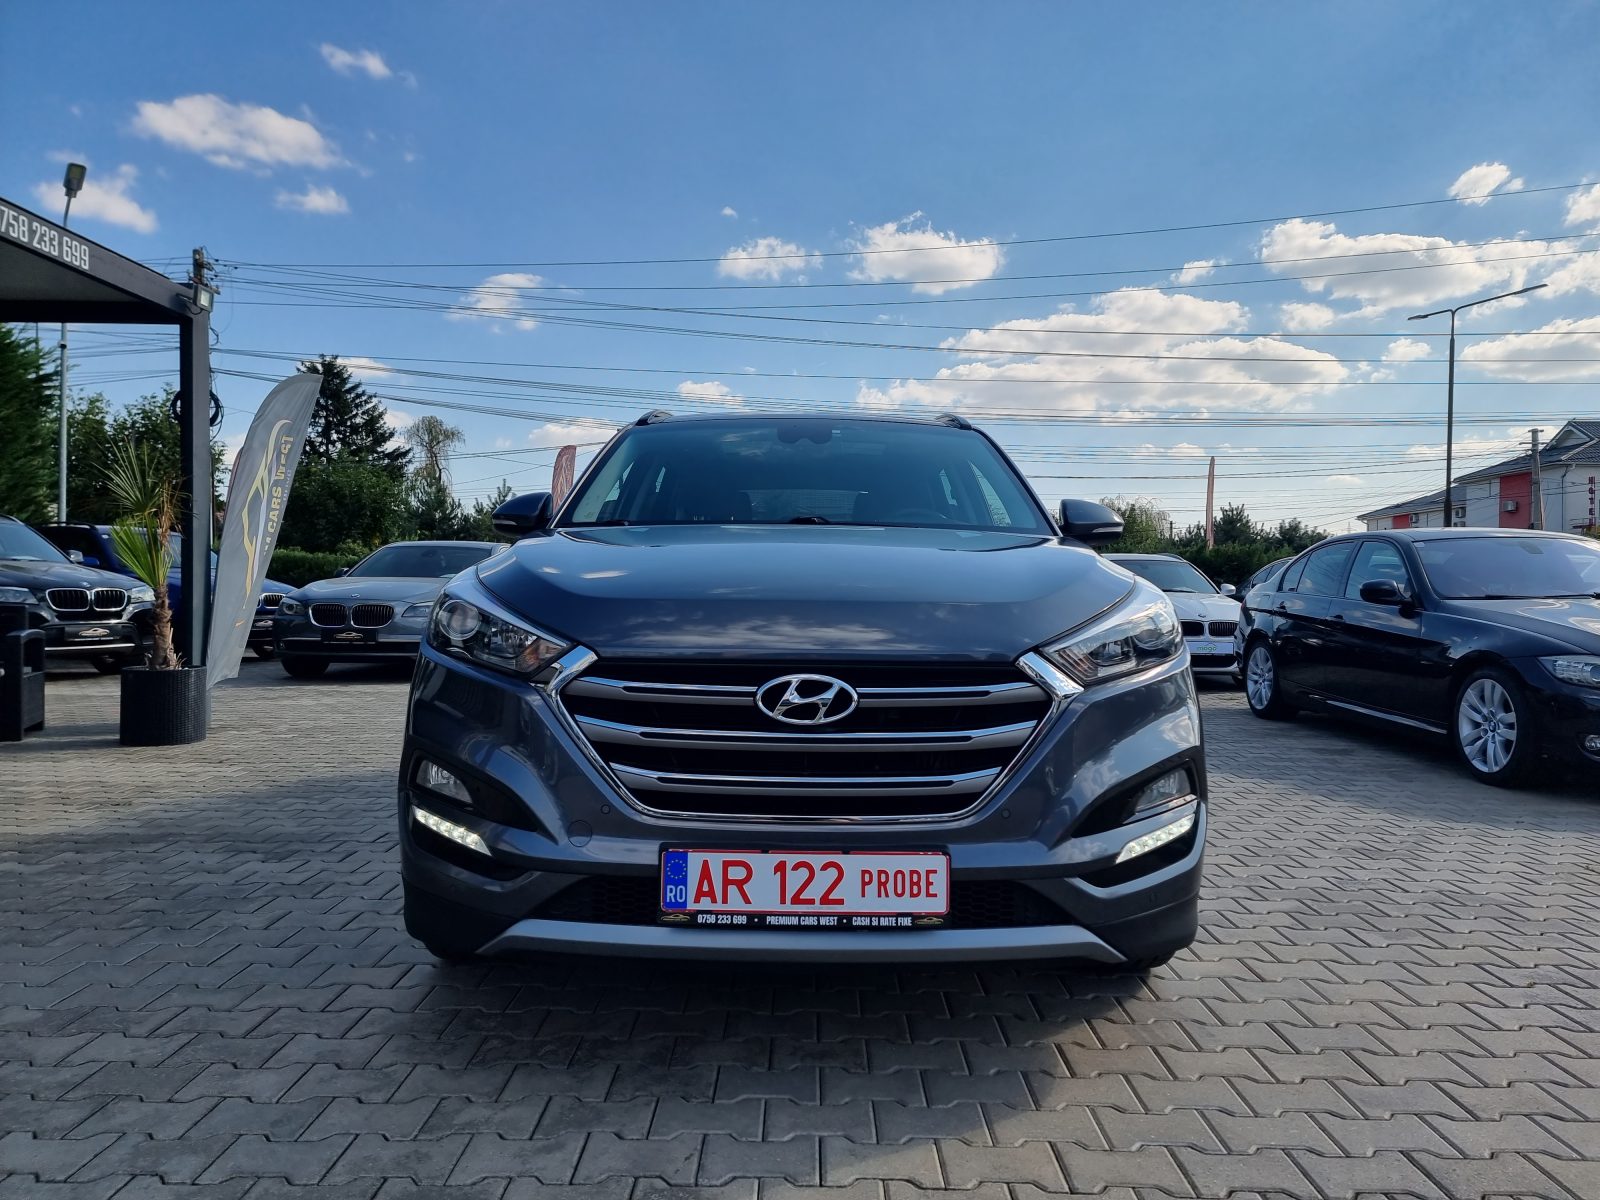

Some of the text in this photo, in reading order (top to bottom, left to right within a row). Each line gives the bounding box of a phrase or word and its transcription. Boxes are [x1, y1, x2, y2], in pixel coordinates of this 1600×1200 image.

[32, 221, 59, 257] 233
[62, 236, 89, 270] 699
[267, 486, 282, 533] CARS
[666, 859, 938, 905] RO AR 122 PROBE
[697, 914, 716, 924] 0758
[717, 914, 731, 924] 233
[732, 915, 747, 925] 699
[766, 915, 799, 925] PREMIUM
[800, 916, 818, 926] CARS
[819, 916, 838, 926] WEST
[852, 916, 870, 926] CASH
[880, 917, 897, 926] RATE
[898, 917, 912, 926] FIXE
